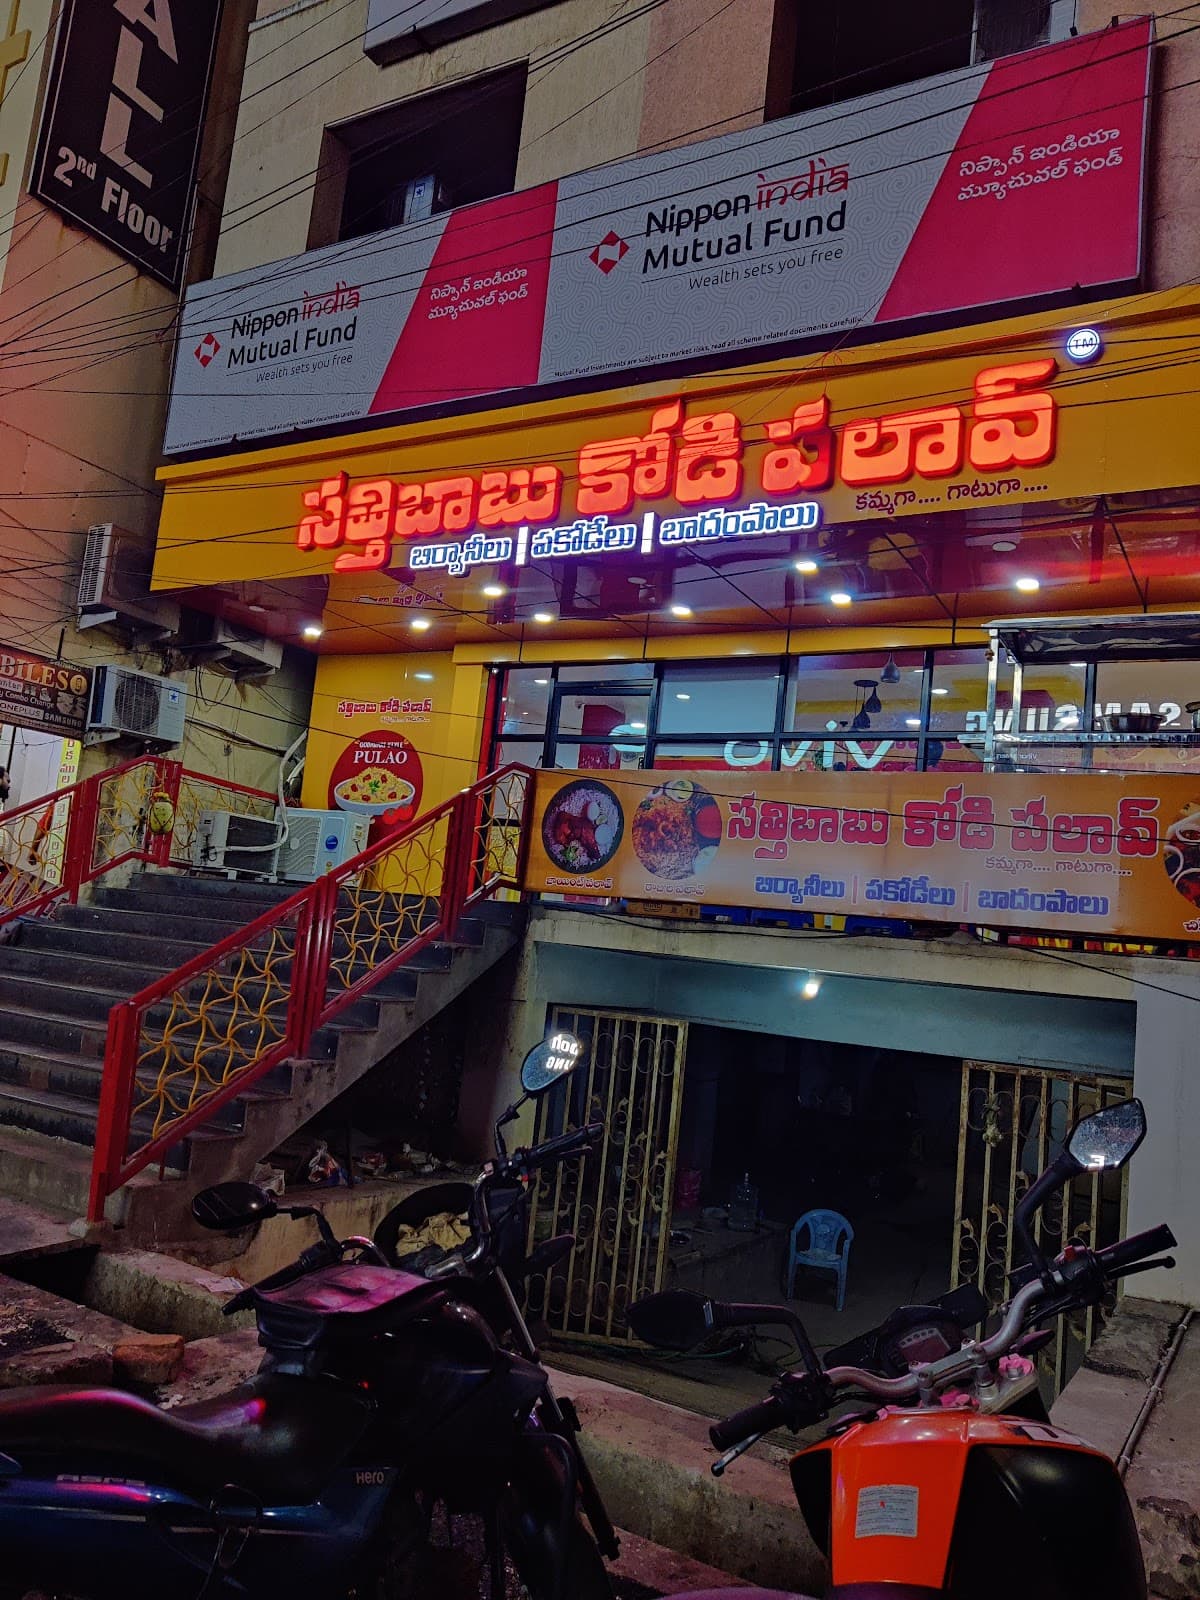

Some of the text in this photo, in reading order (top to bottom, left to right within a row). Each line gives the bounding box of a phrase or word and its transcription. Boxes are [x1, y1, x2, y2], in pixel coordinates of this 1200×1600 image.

[957, 146, 1123, 201] మ్యూచువల్ ఫండ్
[959, 128, 1120, 177] నిప్పాన్ ఇండియా
[53, 146, 173, 253] 2nd Floor
[646, 157, 850, 237] Nippon india
[642, 200, 847, 274] Mutual Fund
[430, 268, 528, 301] నిప్పాన్ ఇండియా
[689, 248, 843, 290] Wealth sets you free
[231, 280, 361, 340] Nippon india
[428, 283, 528, 320] మ్యూచువల్ ఫండ్
[227, 315, 358, 368] Mutual Fund
[575, 366, 590, 374] Fund
[627, 357, 637, 366] are
[638, 353, 660, 365] subject
[670, 347, 693, 358] market
[711, 341, 726, 349] read
[727, 339, 736, 347] all
[736, 335, 762, 345] scheme
[763, 330, 788, 341] related
[789, 323, 828, 335] documents
[256, 353, 353, 383] Wealth sets you free
[297, 357, 1059, 572] సత్తిబాబు కోడి పలావ్
[409, 501, 819, 576] బిర్యానీలు పకోడీలు బాదంపాలు
[30, 697, 55, 709] Change
[44, 712, 82, 728] SAMSUNG
[353, 750, 408, 764] PULAO
[727, 784, 1160, 860] సత్తిబాబు కోడి పలావ్
[754, 873, 1110, 916] బిర్యానీలు పకోడీలు బాదంపాలు
